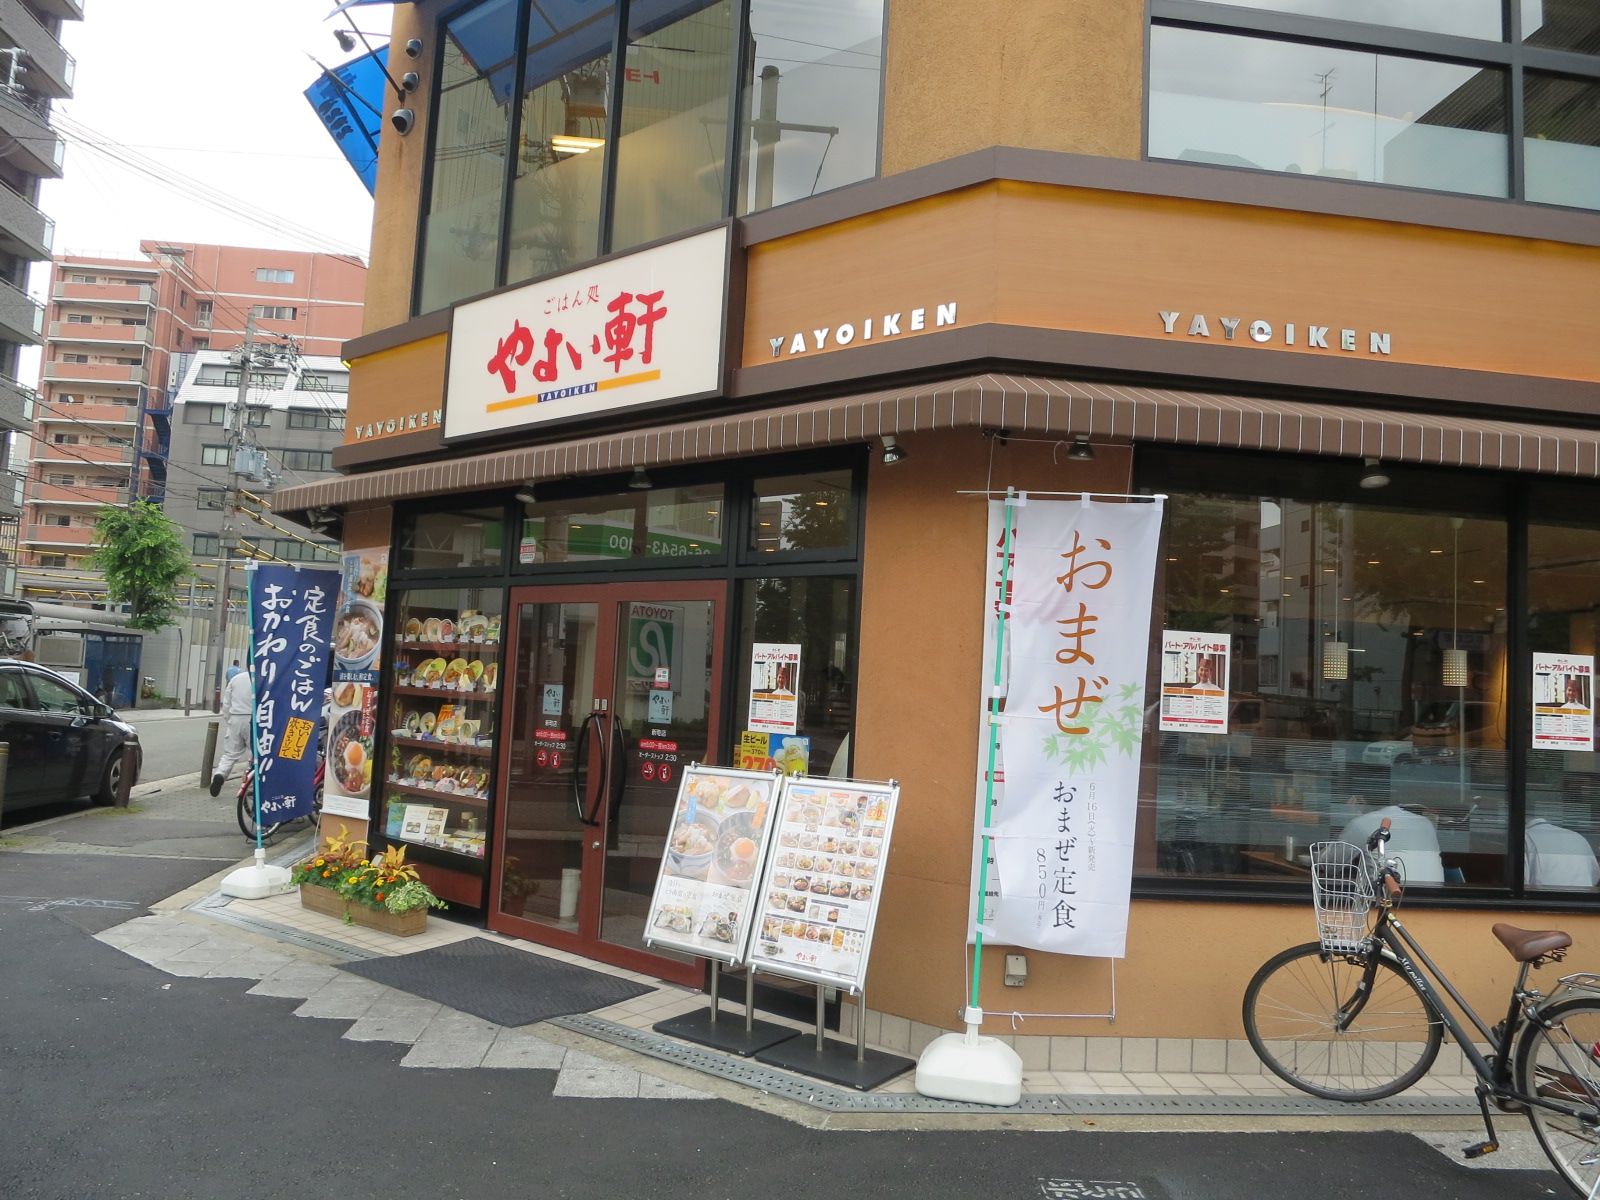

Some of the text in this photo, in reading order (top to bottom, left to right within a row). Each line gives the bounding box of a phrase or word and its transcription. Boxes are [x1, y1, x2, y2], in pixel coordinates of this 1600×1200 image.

[544, 284, 600, 315] ごはん処
[487, 290, 667, 394] やよい軒
[769, 301, 958, 357] YAYOIKEN
[1158, 310, 1392, 355] YAYOIKEN
[540, 382, 597, 402] YAYOIKEN
[355, 409, 442, 440] YAYOIKEN
[291, 586, 327, 713] 定食のごはん
[1038, 530, 1113, 735] おまぜ
[743, 734, 768, 745] 生ビール
[1051, 780, 1078, 929] おまぜ定食
